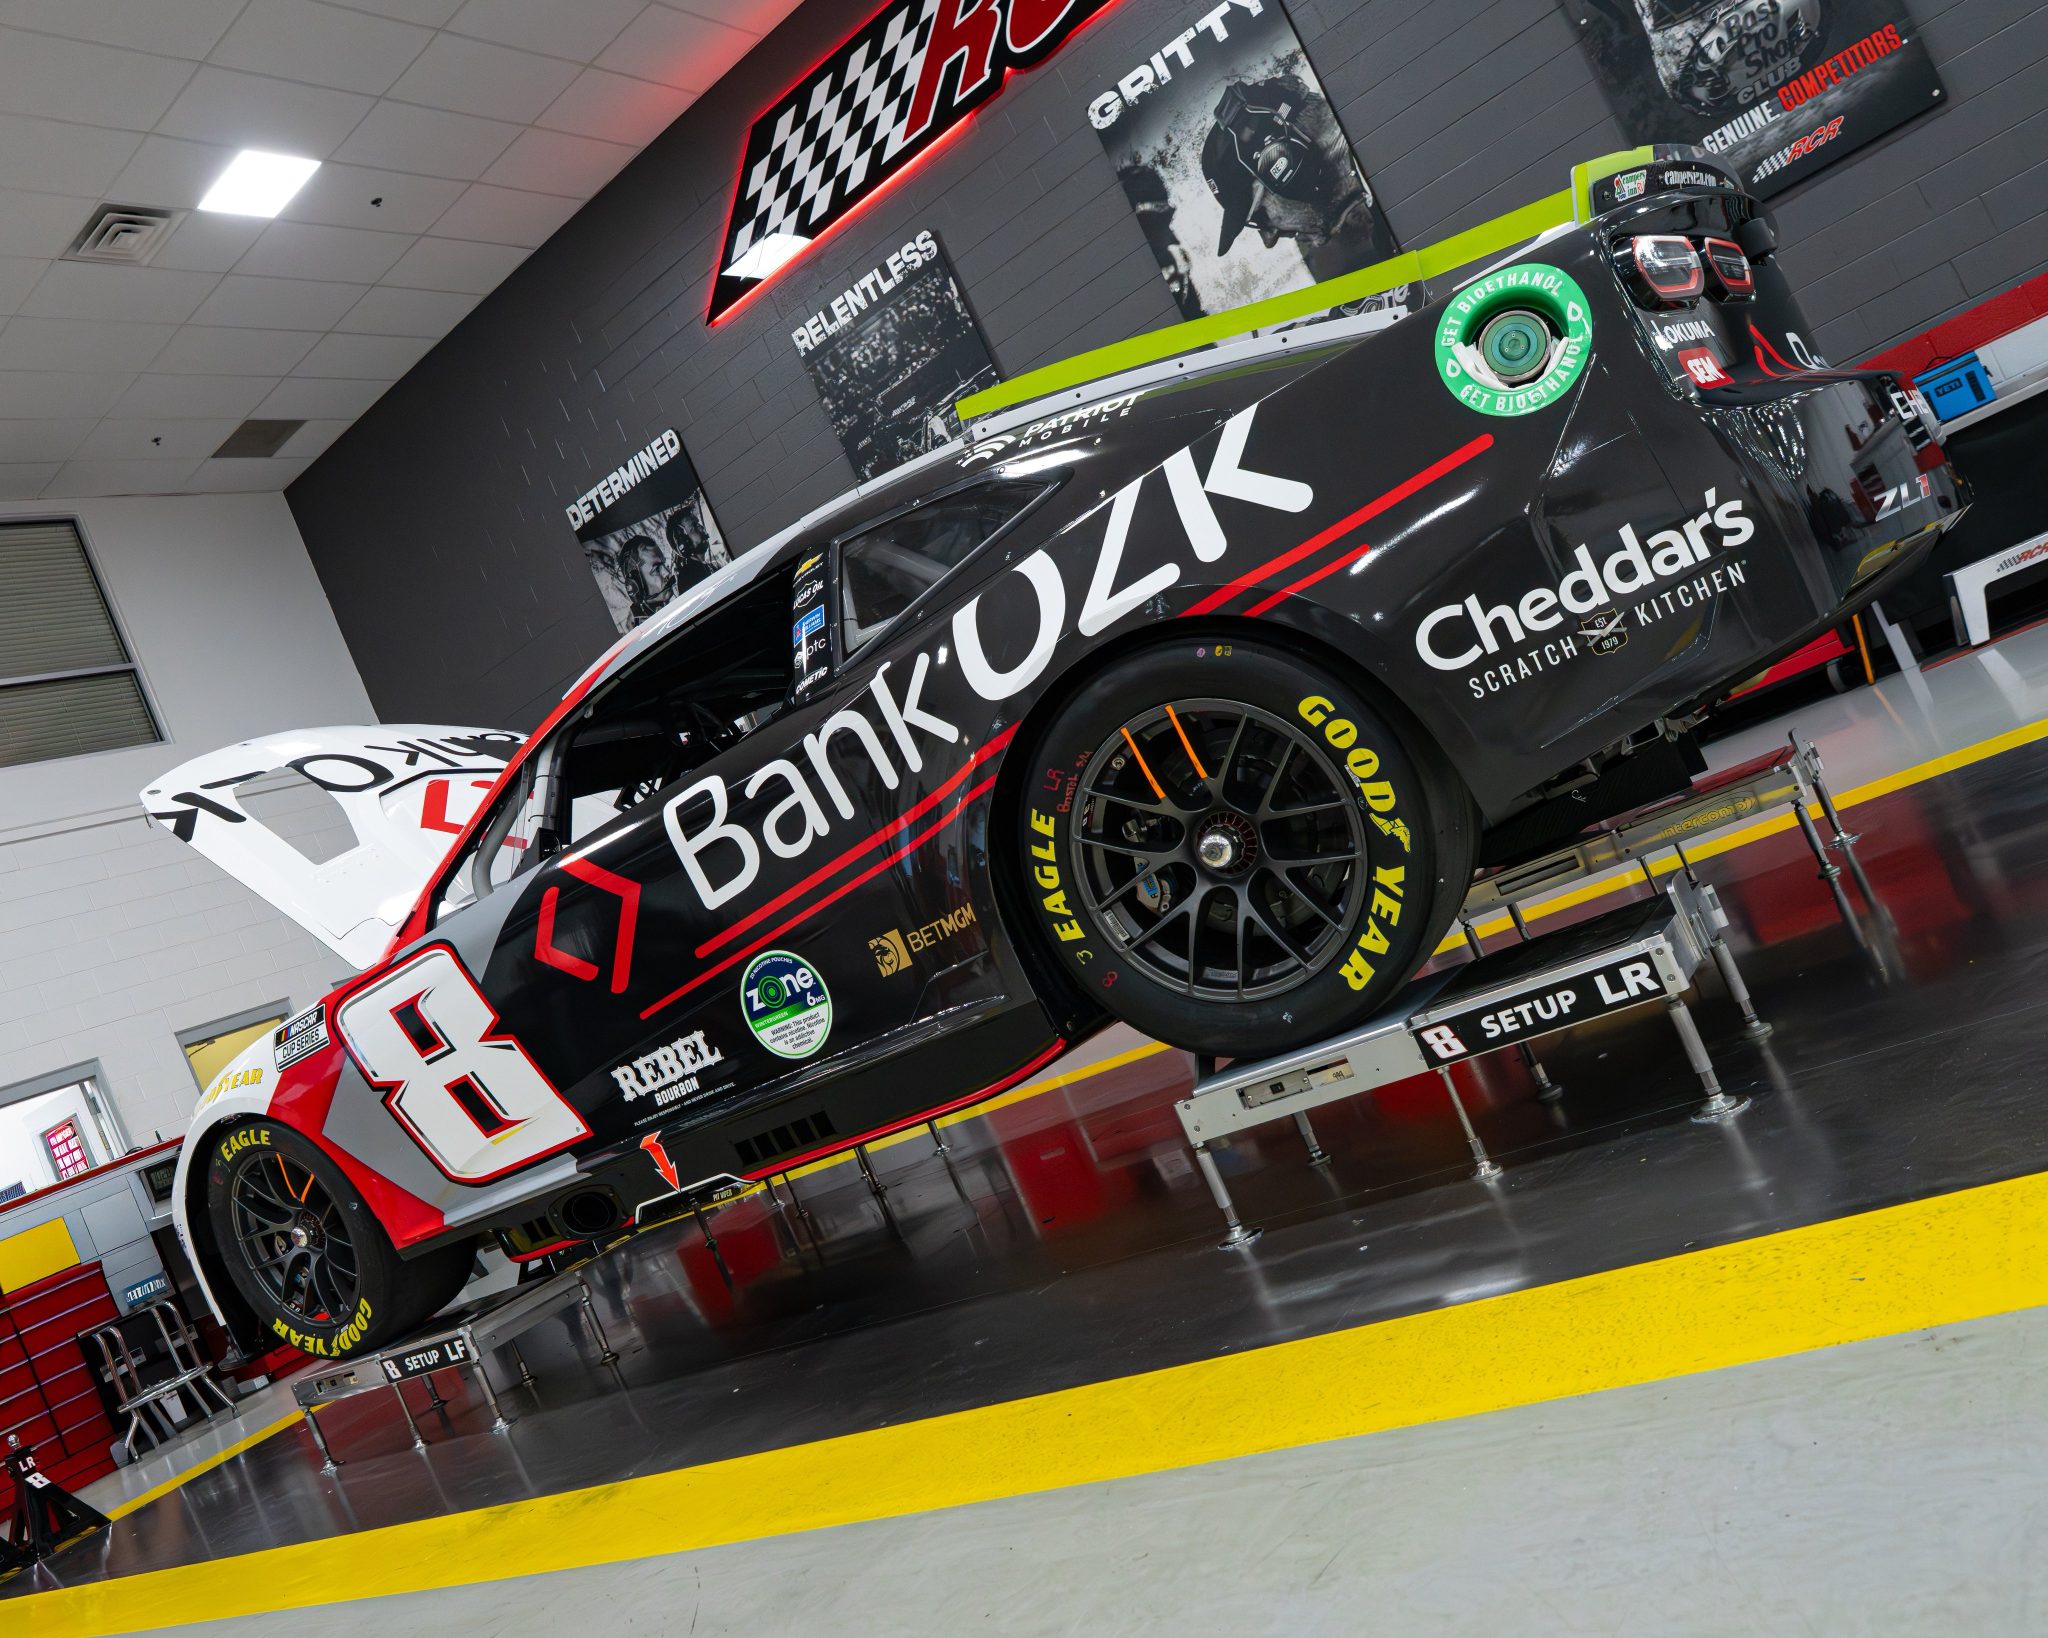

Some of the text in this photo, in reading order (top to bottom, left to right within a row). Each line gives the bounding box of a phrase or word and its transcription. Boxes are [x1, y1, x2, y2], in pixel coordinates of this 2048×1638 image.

[1737, 56, 1802, 105] CLUB
[790, 229, 939, 358] RELENTLESS
[1441, 271, 1564, 347] GET BIOETHANOL
[1662, 320, 1716, 345] OKUMA
[1686, 355, 1726, 384] SEM
[1935, 378, 1962, 397] YETI
[1023, 391, 1146, 438] PATRIOT
[1459, 384, 1492, 409] GET
[1019, 406, 1132, 448] MOBILE
[565, 428, 681, 532] DETERMINED
[1873, 473, 1931, 522] ZL1
[1415, 486, 1755, 671] Cheddar's
[806, 638, 827, 661] ptc
[1469, 564, 1748, 699] SCRATCH KITCHEN
[1601, 636, 1619, 650] 1979
[661, 401, 1314, 912] Bank OZK
[795, 667, 828, 695] COMETIC
[1030, 808, 1087, 942] EAGLE
[906, 902, 978, 953] BETMGM
[289, 1011, 318, 1038] NASCAR
[1420, 962, 1661, 1060] 8 SETUP LR
[283, 1028, 320, 1059] CUP SERIES
[331, 938, 595, 1184] 8
[610, 1030, 722, 1102] REBEL
[654, 1076, 700, 1107] BOURBON
[220, 1129, 272, 1163] EAGLE
[383, 1339, 466, 1379] 8 SETUP LF
[18, 1456, 36, 1472] LR
[25, 1472, 52, 1489] 8
